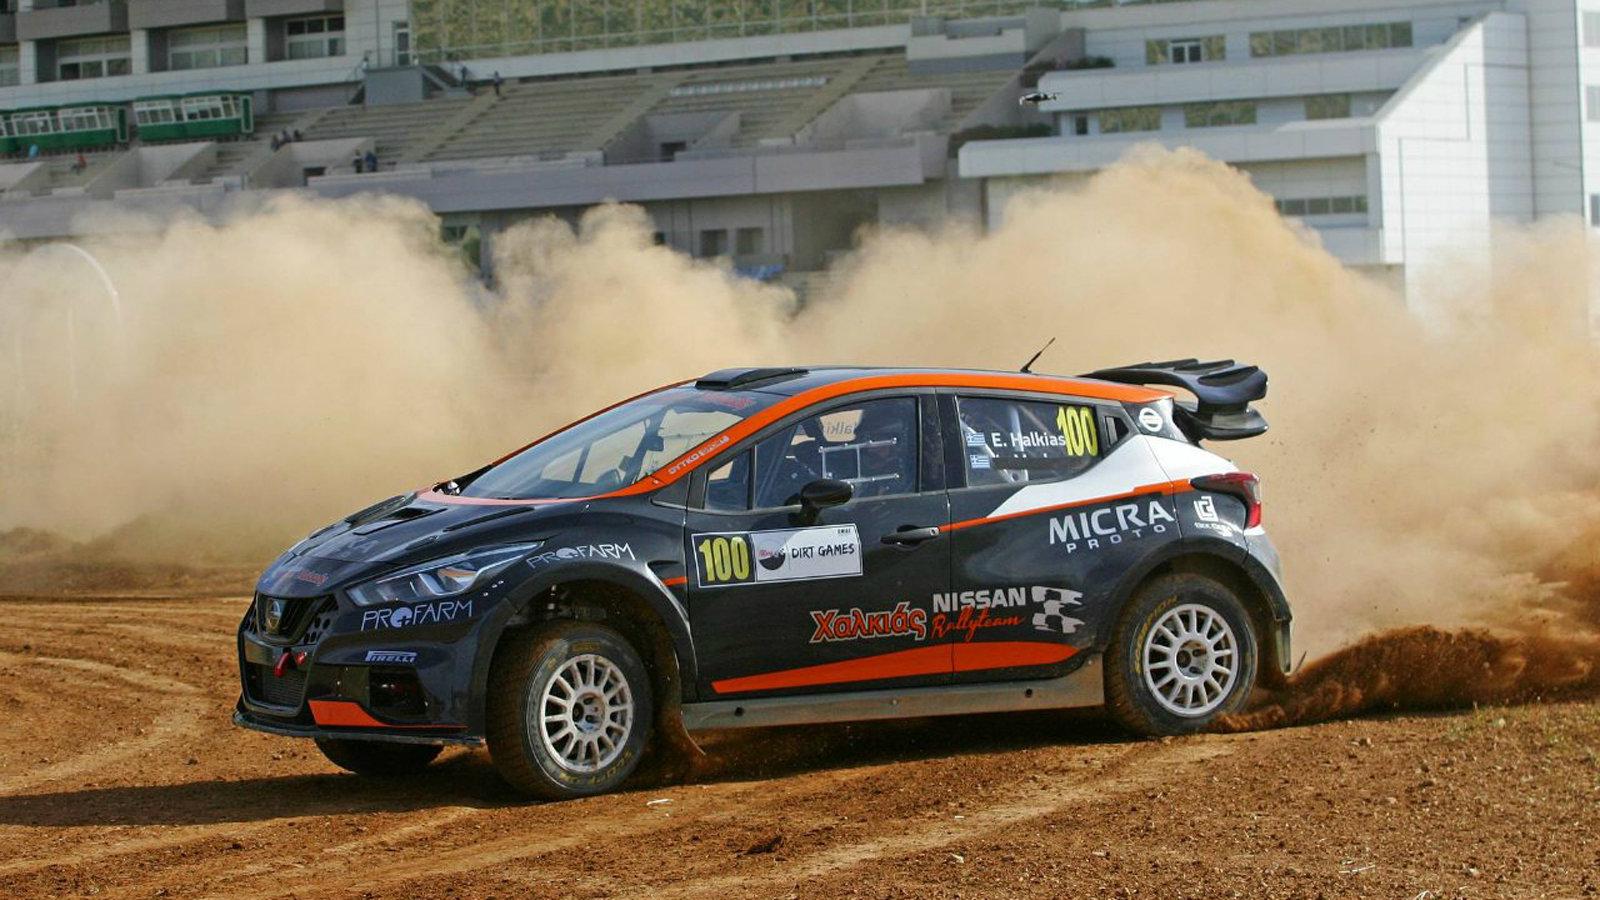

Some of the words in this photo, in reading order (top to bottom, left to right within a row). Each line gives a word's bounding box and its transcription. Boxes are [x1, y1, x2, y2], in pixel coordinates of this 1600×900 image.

[991, 432, 1007, 447] E.
[1010, 431, 1066, 447] Halkias
[1056, 406, 1098, 456] 100
[1049, 500, 1176, 545] MICRA
[791, 545, 815, 559] DIRT
[818, 543, 855, 557] GAMES
[1066, 524, 1166, 553] PROTO
[526, 543, 636, 569] PROFARM
[699, 536, 750, 581] 100
[933, 587, 1026, 613] NISSAN
[361, 600, 473, 632] PROFARM
[809, 601, 927, 643] Χαλκιάς
